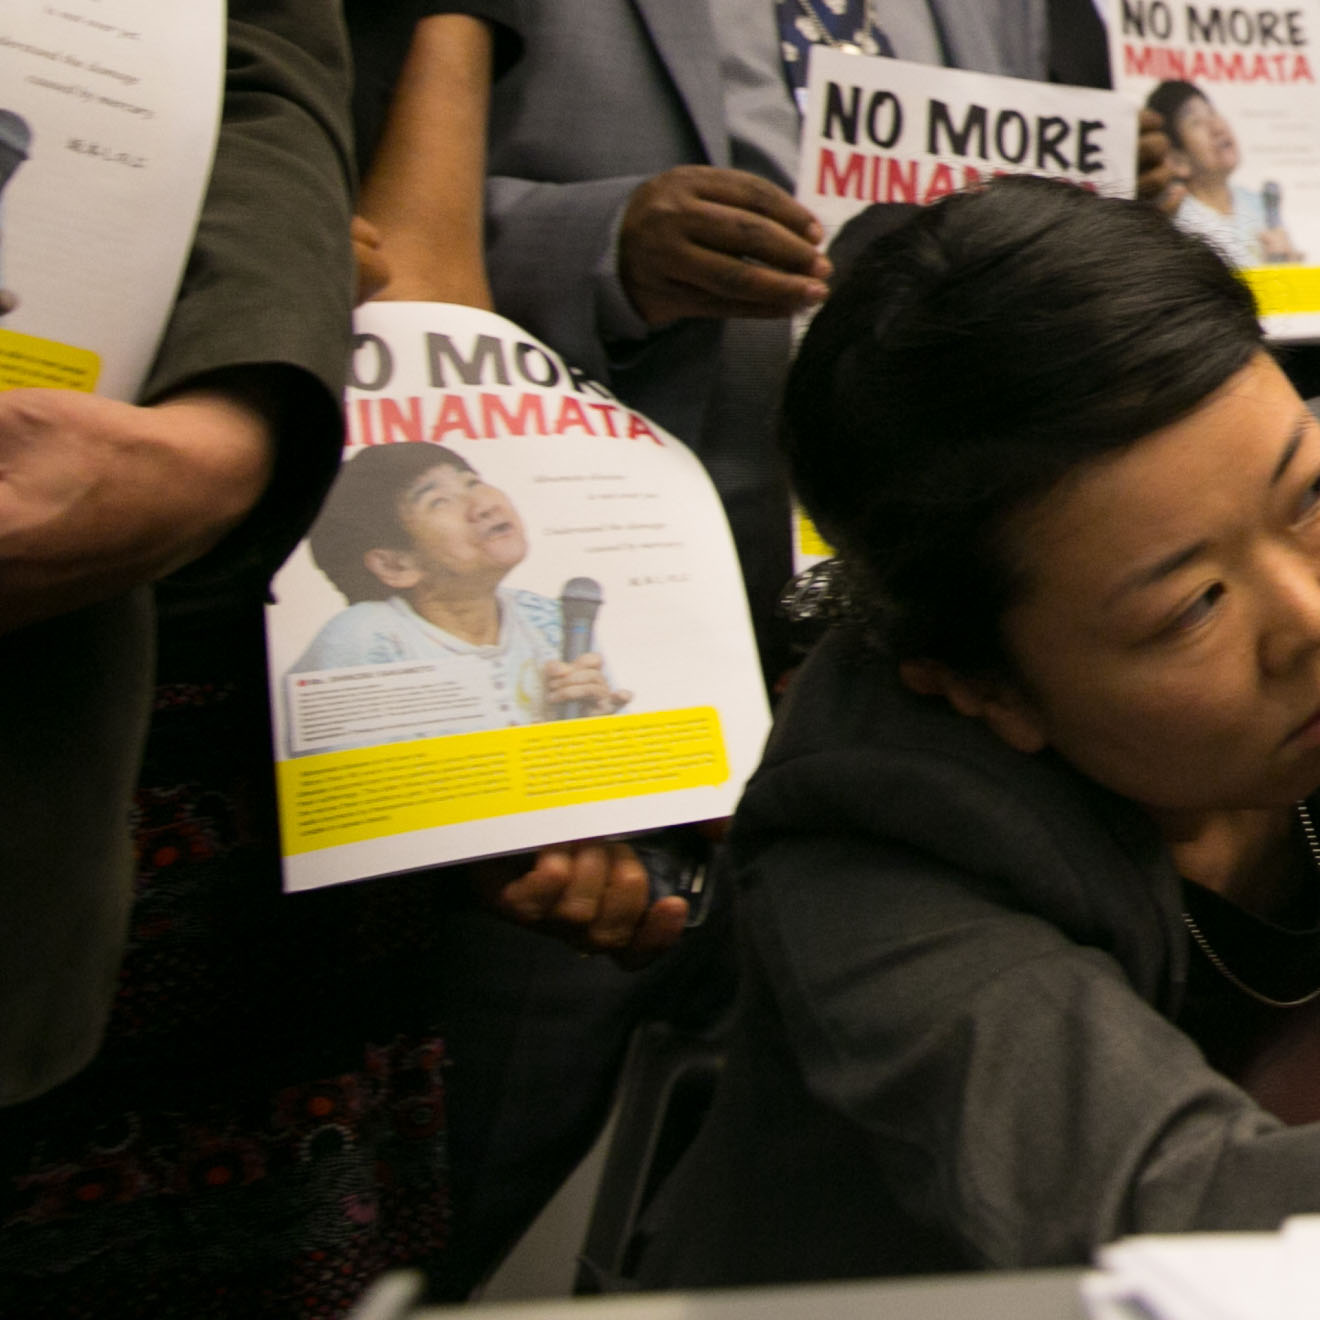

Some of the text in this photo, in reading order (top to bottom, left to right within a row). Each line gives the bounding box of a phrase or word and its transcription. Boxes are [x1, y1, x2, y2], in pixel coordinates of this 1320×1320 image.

[1186, 4, 1308, 48] MORE
[1123, 43, 1316, 84] MINAMATA
[822, 81, 1107, 174] NO MORE
[346, 333, 393, 391] O
[345, 392, 666, 447] INAMATA
